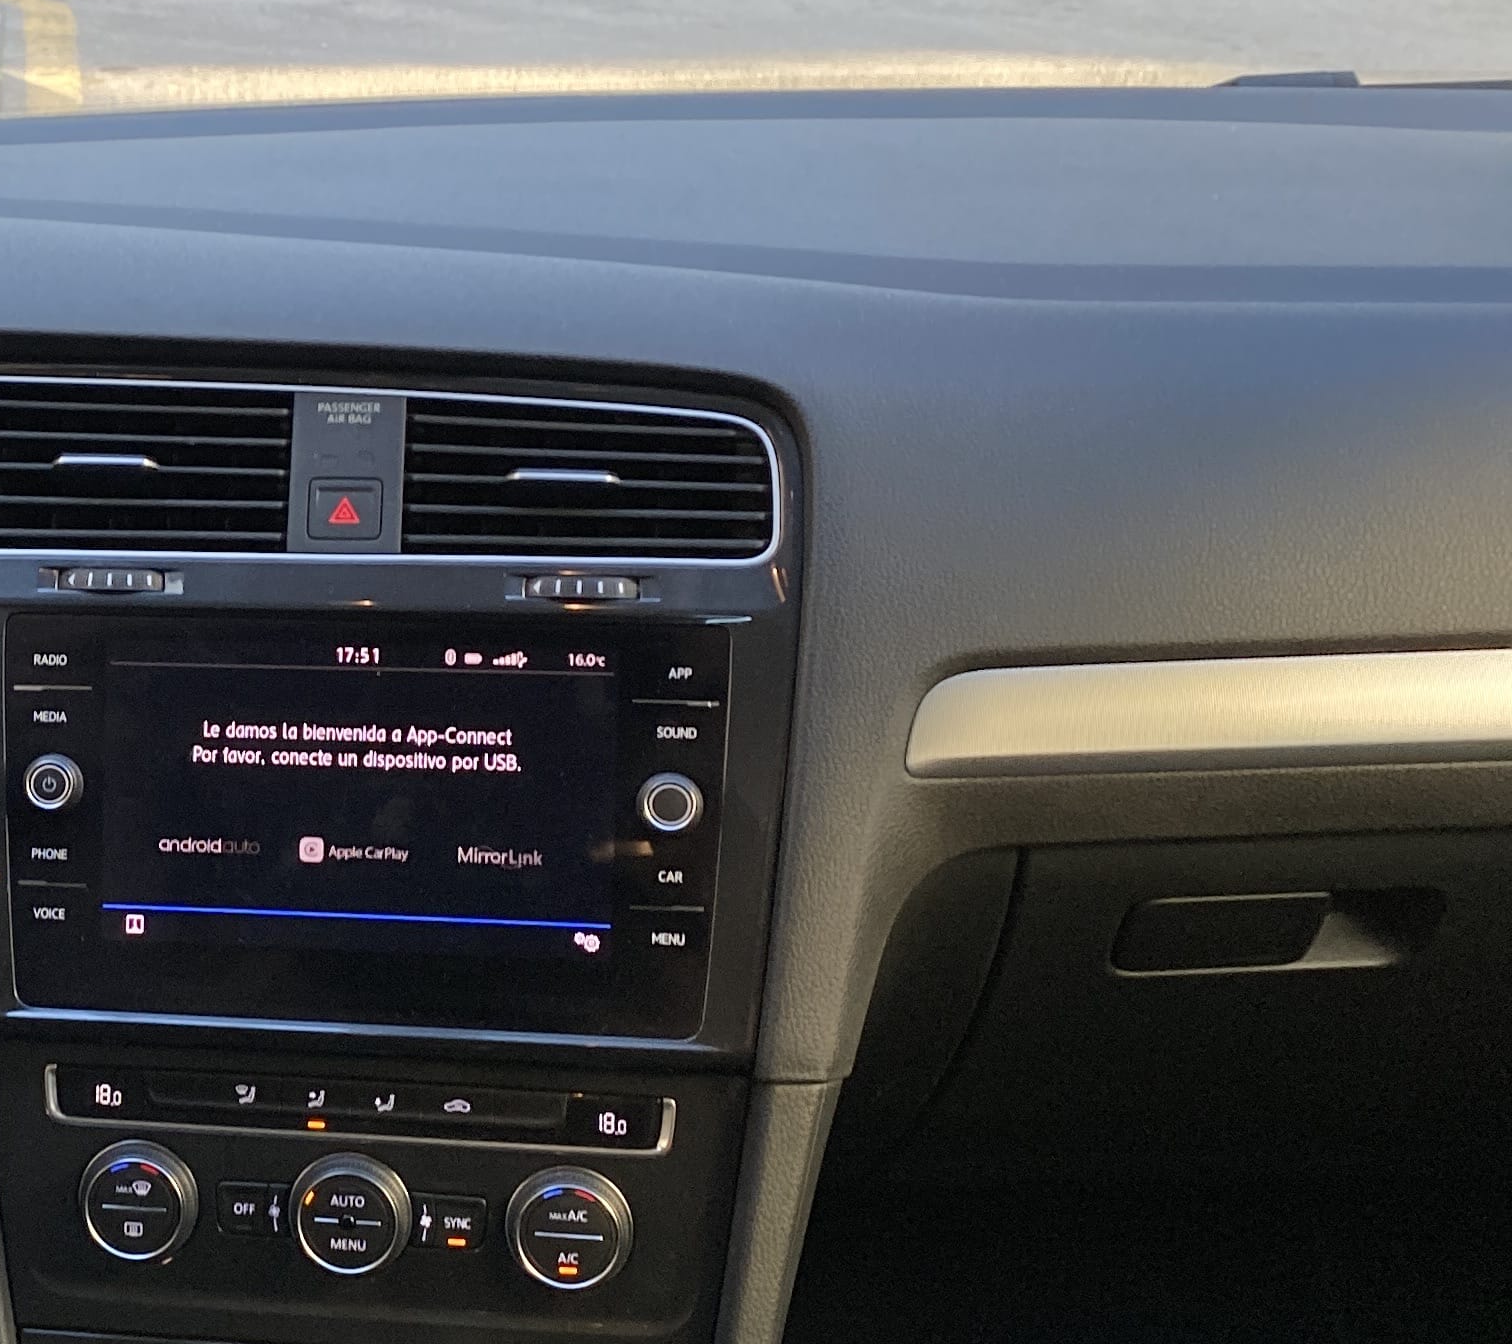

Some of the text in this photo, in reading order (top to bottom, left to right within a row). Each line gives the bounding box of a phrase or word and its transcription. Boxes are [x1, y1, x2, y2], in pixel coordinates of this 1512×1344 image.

[317, 401, 381, 413] PASSENGER
[326, 413, 372, 424] AIR BAG
[33, 653, 68, 666] RADIO
[336, 646, 380, 665] 17:51
[668, 666, 694, 680] APP
[33, 710, 68, 723] MEDIA
[203, 720, 513, 747] Le damos la bienvenida a App-Connect
[656, 725, 698, 740] SOUND
[192, 744, 522, 773] Por favor, conecte un dispositivo por USB.
[31, 847, 68, 861] PHONE
[328, 844, 409, 863] Apple CarPlay
[457, 845, 543, 869] MirrorLink
[657, 870, 684, 884] CAR
[32, 907, 67, 921] VOICE
[651, 931, 686, 947] MENU
[95, 1083, 122, 1106] 18.0
[598, 1111, 627, 1136] 18.0
[233, 1202, 256, 1215] OFF
[330, 1194, 366, 1209] AUTO
[443, 1216, 471, 1230] SYNC
[567, 1209, 588, 1223] A/C
[330, 1237, 367, 1253] MENU
[557, 1252, 579, 1265] A/C
